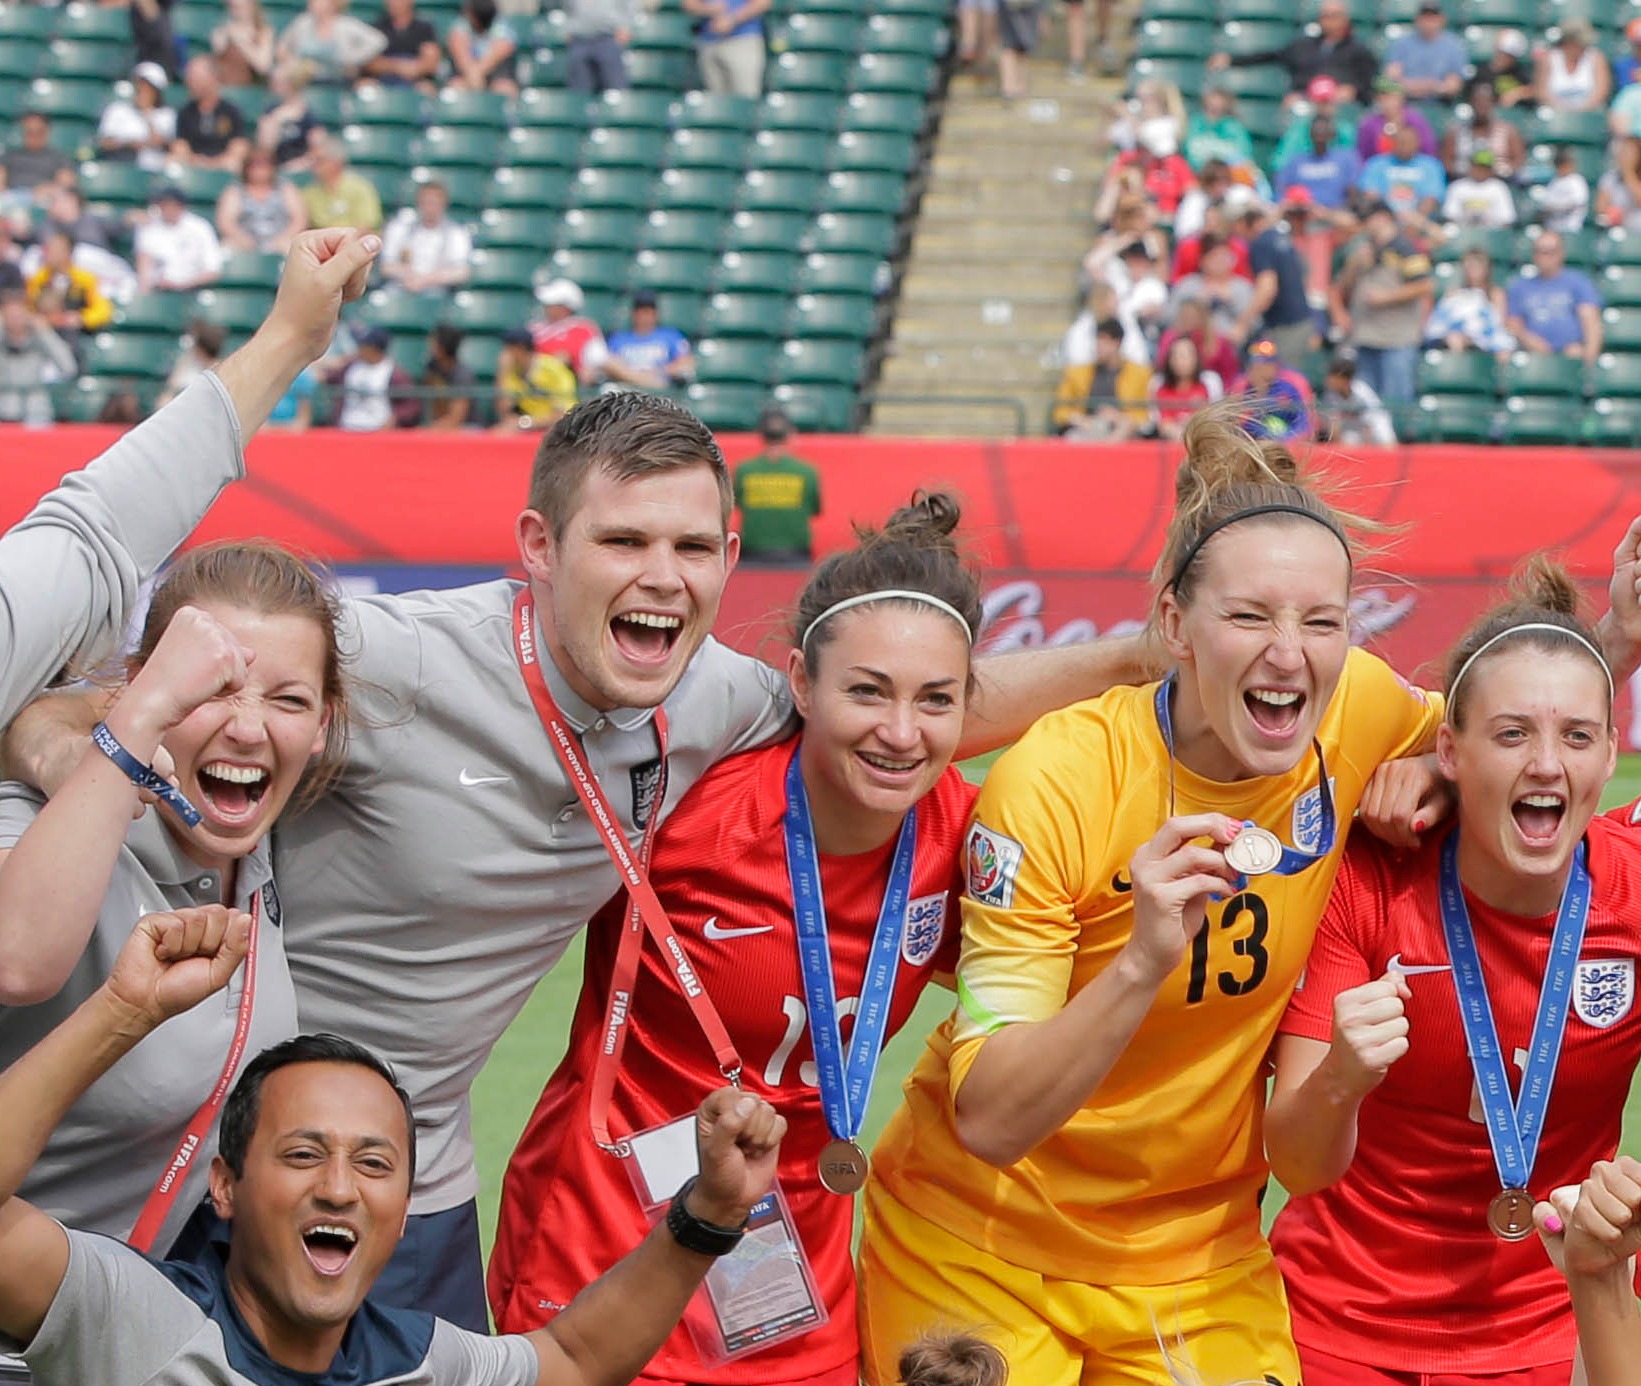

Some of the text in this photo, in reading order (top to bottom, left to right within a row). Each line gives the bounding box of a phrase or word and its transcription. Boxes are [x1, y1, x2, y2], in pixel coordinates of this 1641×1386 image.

[799, 872, 810, 898] FIFA
[1568, 894, 1581, 919] FIFA
[803, 911, 815, 937] FIFA
[882, 927, 894, 952] FIFA
[1187, 892, 1268, 1004] 13
[1561, 931, 1573, 956] FIFA
[810, 949, 822, 975] FIFA
[875, 964, 886, 990] FIFA
[1553, 968, 1565, 992] FIFA
[815, 988, 827, 1013] FIFA
[1469, 997, 1482, 1022] FIFA
[1478, 1035, 1491, 1058] FIFA
[1486, 1072, 1500, 1095] FIFA
[538, 1300, 566, 1311] DRI-F
